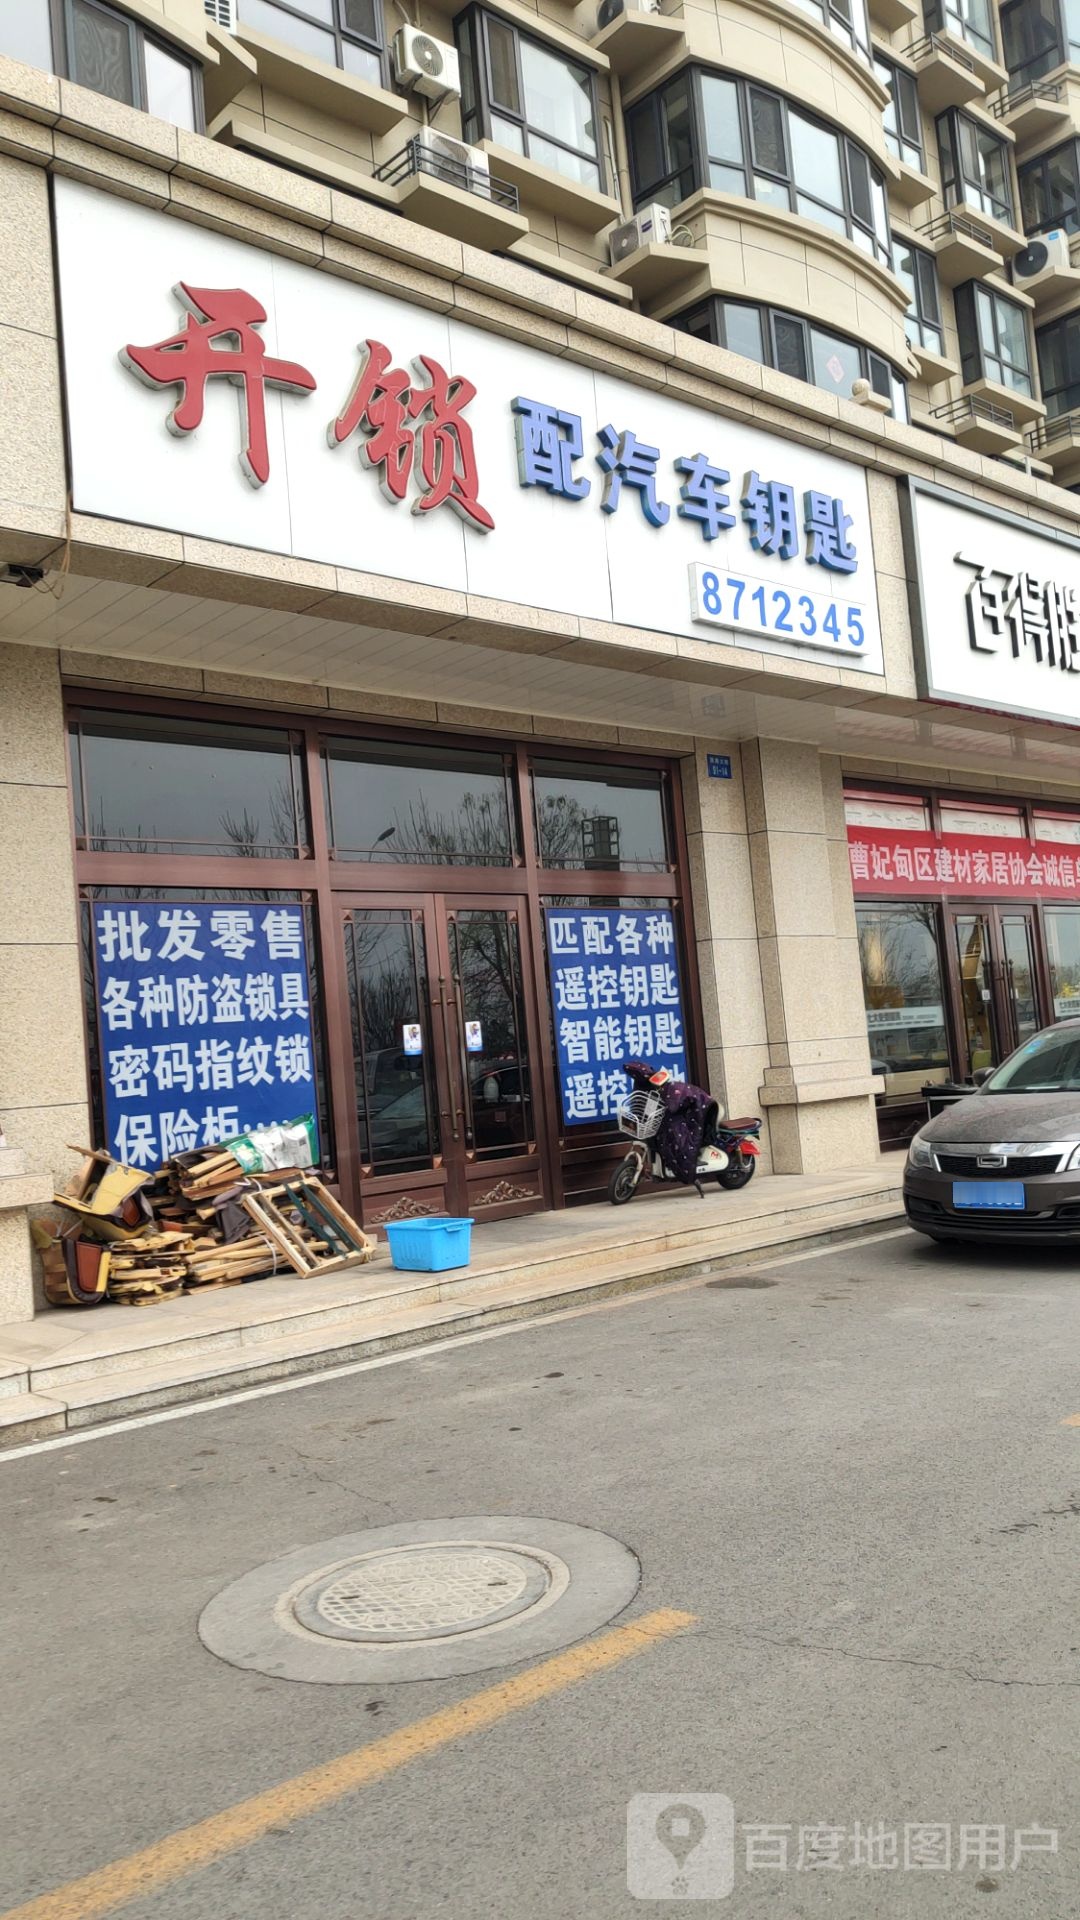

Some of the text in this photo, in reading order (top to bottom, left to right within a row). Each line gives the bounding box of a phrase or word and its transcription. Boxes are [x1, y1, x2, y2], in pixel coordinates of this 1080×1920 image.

[119, 281, 496, 533] 开锁
[511, 396, 858, 575] 配汽车钥匙
[702, 571, 865, 647] 8712345
[97, 909, 303, 962] 批发零售
[549, 914, 674, 955] 匹配各种
[102, 972, 309, 1031] 各种防盗锁具
[555, 963, 680, 1011] 遥控钥匙
[108, 1033, 312, 1098] 密码指纹锁
[560, 1011, 684, 1064] 智能钥匙
[565, 1064, 685, 1119] 遥控
